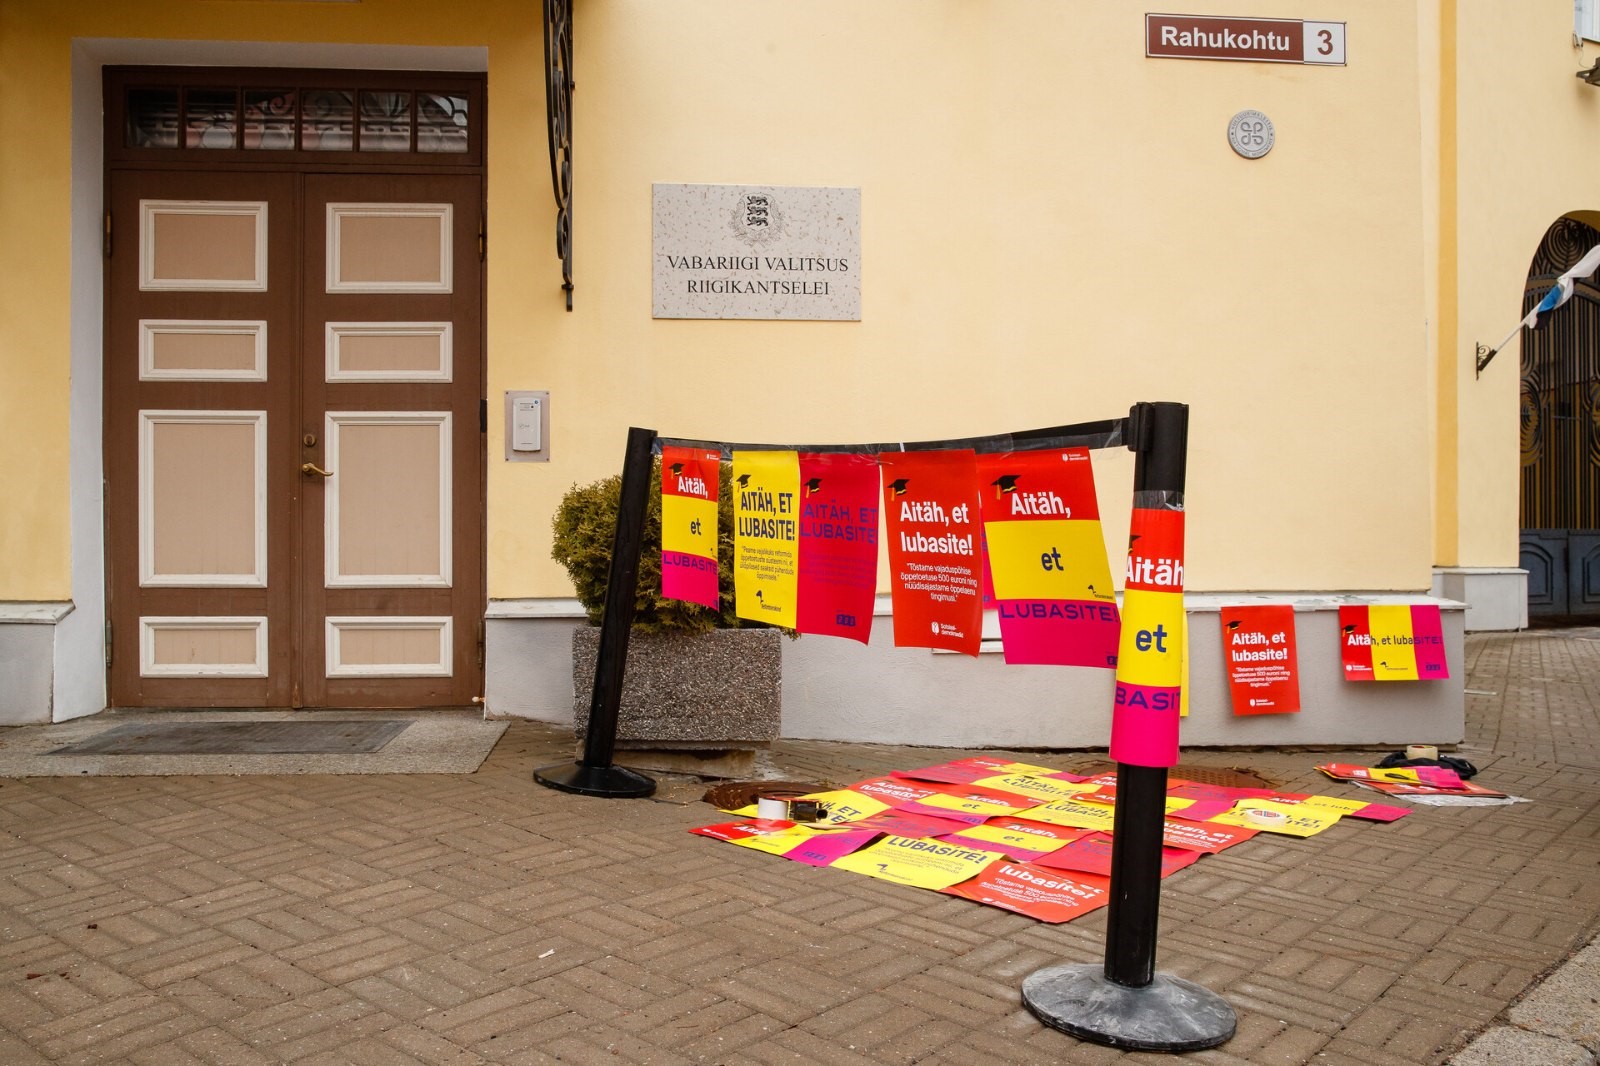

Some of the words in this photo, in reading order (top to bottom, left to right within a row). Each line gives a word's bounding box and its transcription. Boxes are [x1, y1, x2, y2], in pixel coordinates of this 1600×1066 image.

[1161, 26, 1290, 51] Rahukohtu
[1317, 30, 1333, 55] 3
[667, 255, 759, 270] VABARIIGI
[765, 257, 849, 272] VALITSUS
[687, 280, 829, 295] RIIGIKANTSELEI
[678, 476, 708, 499] Aitäh,
[741, 487, 776, 516] AITÄH,
[778, 493, 793, 514] ET
[803, 499, 853, 523] AITÄH,
[860, 507, 877, 524] ET
[900, 501, 949, 526] Aitäh,
[952, 502, 969, 524] et
[1011, 491, 1071, 518] Aitäh,
[690, 518, 702, 536] et
[739, 517, 795, 541] LUBASITE!
[900, 531, 973, 556] lubasite!
[1041, 547, 1064, 571] et
[937, 574, 950, 582] 500
[1000, 603, 1119, 623] LUBASITE!
[1135, 624, 1167, 653] et
[1232, 632, 1269, 646] Aitäh,
[1272, 632, 1286, 643] et
[1347, 634, 1379, 646] Aitäh,
[1381, 635, 1392, 645] et
[1232, 647, 1288, 662] lubasite!
[837, 806, 862, 816] ET
[888, 837, 988, 864] LUBASITE!
[998, 865, 1096, 899] lubasite!
